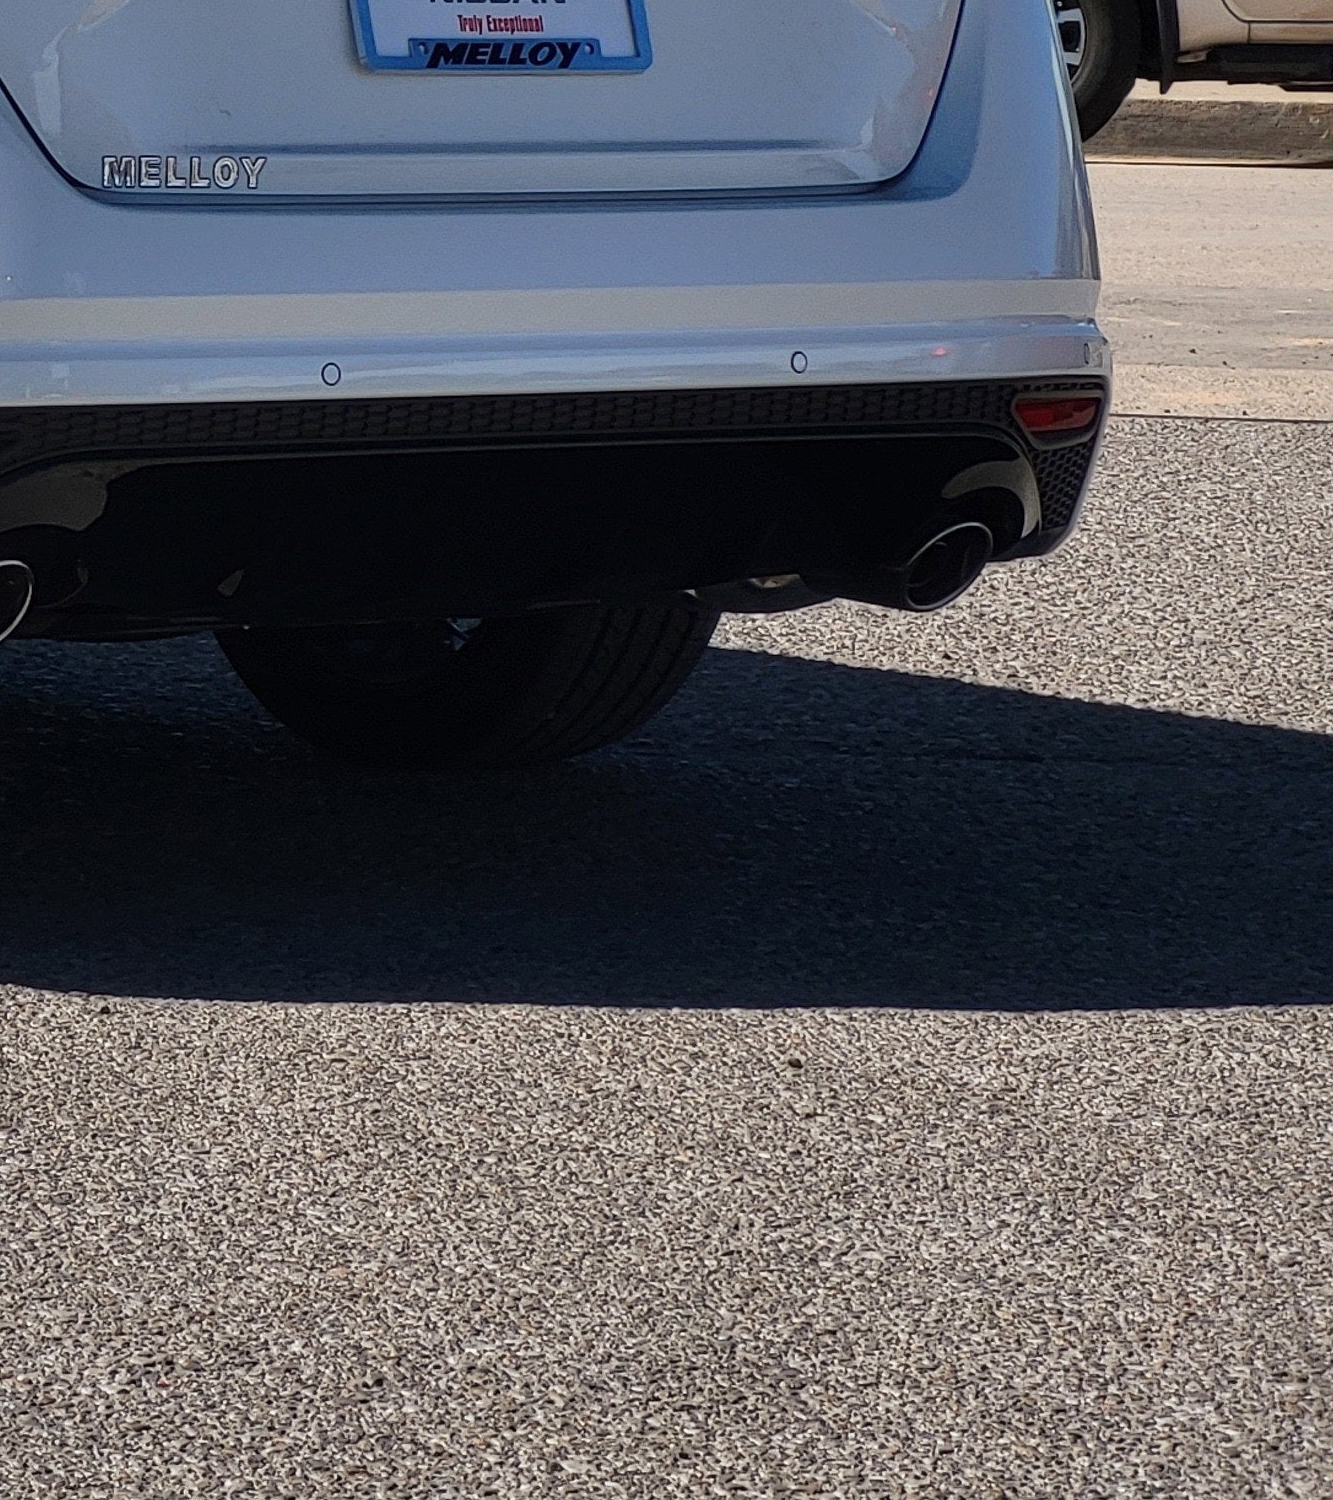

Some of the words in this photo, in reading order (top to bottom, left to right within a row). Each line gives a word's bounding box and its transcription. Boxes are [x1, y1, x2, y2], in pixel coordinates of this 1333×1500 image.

[457, 14, 483, 35] Truly
[486, 14, 544, 36] Exceptional
[427, 41, 583, 69] MELLOY
[102, 155, 267, 190] MELLOY
